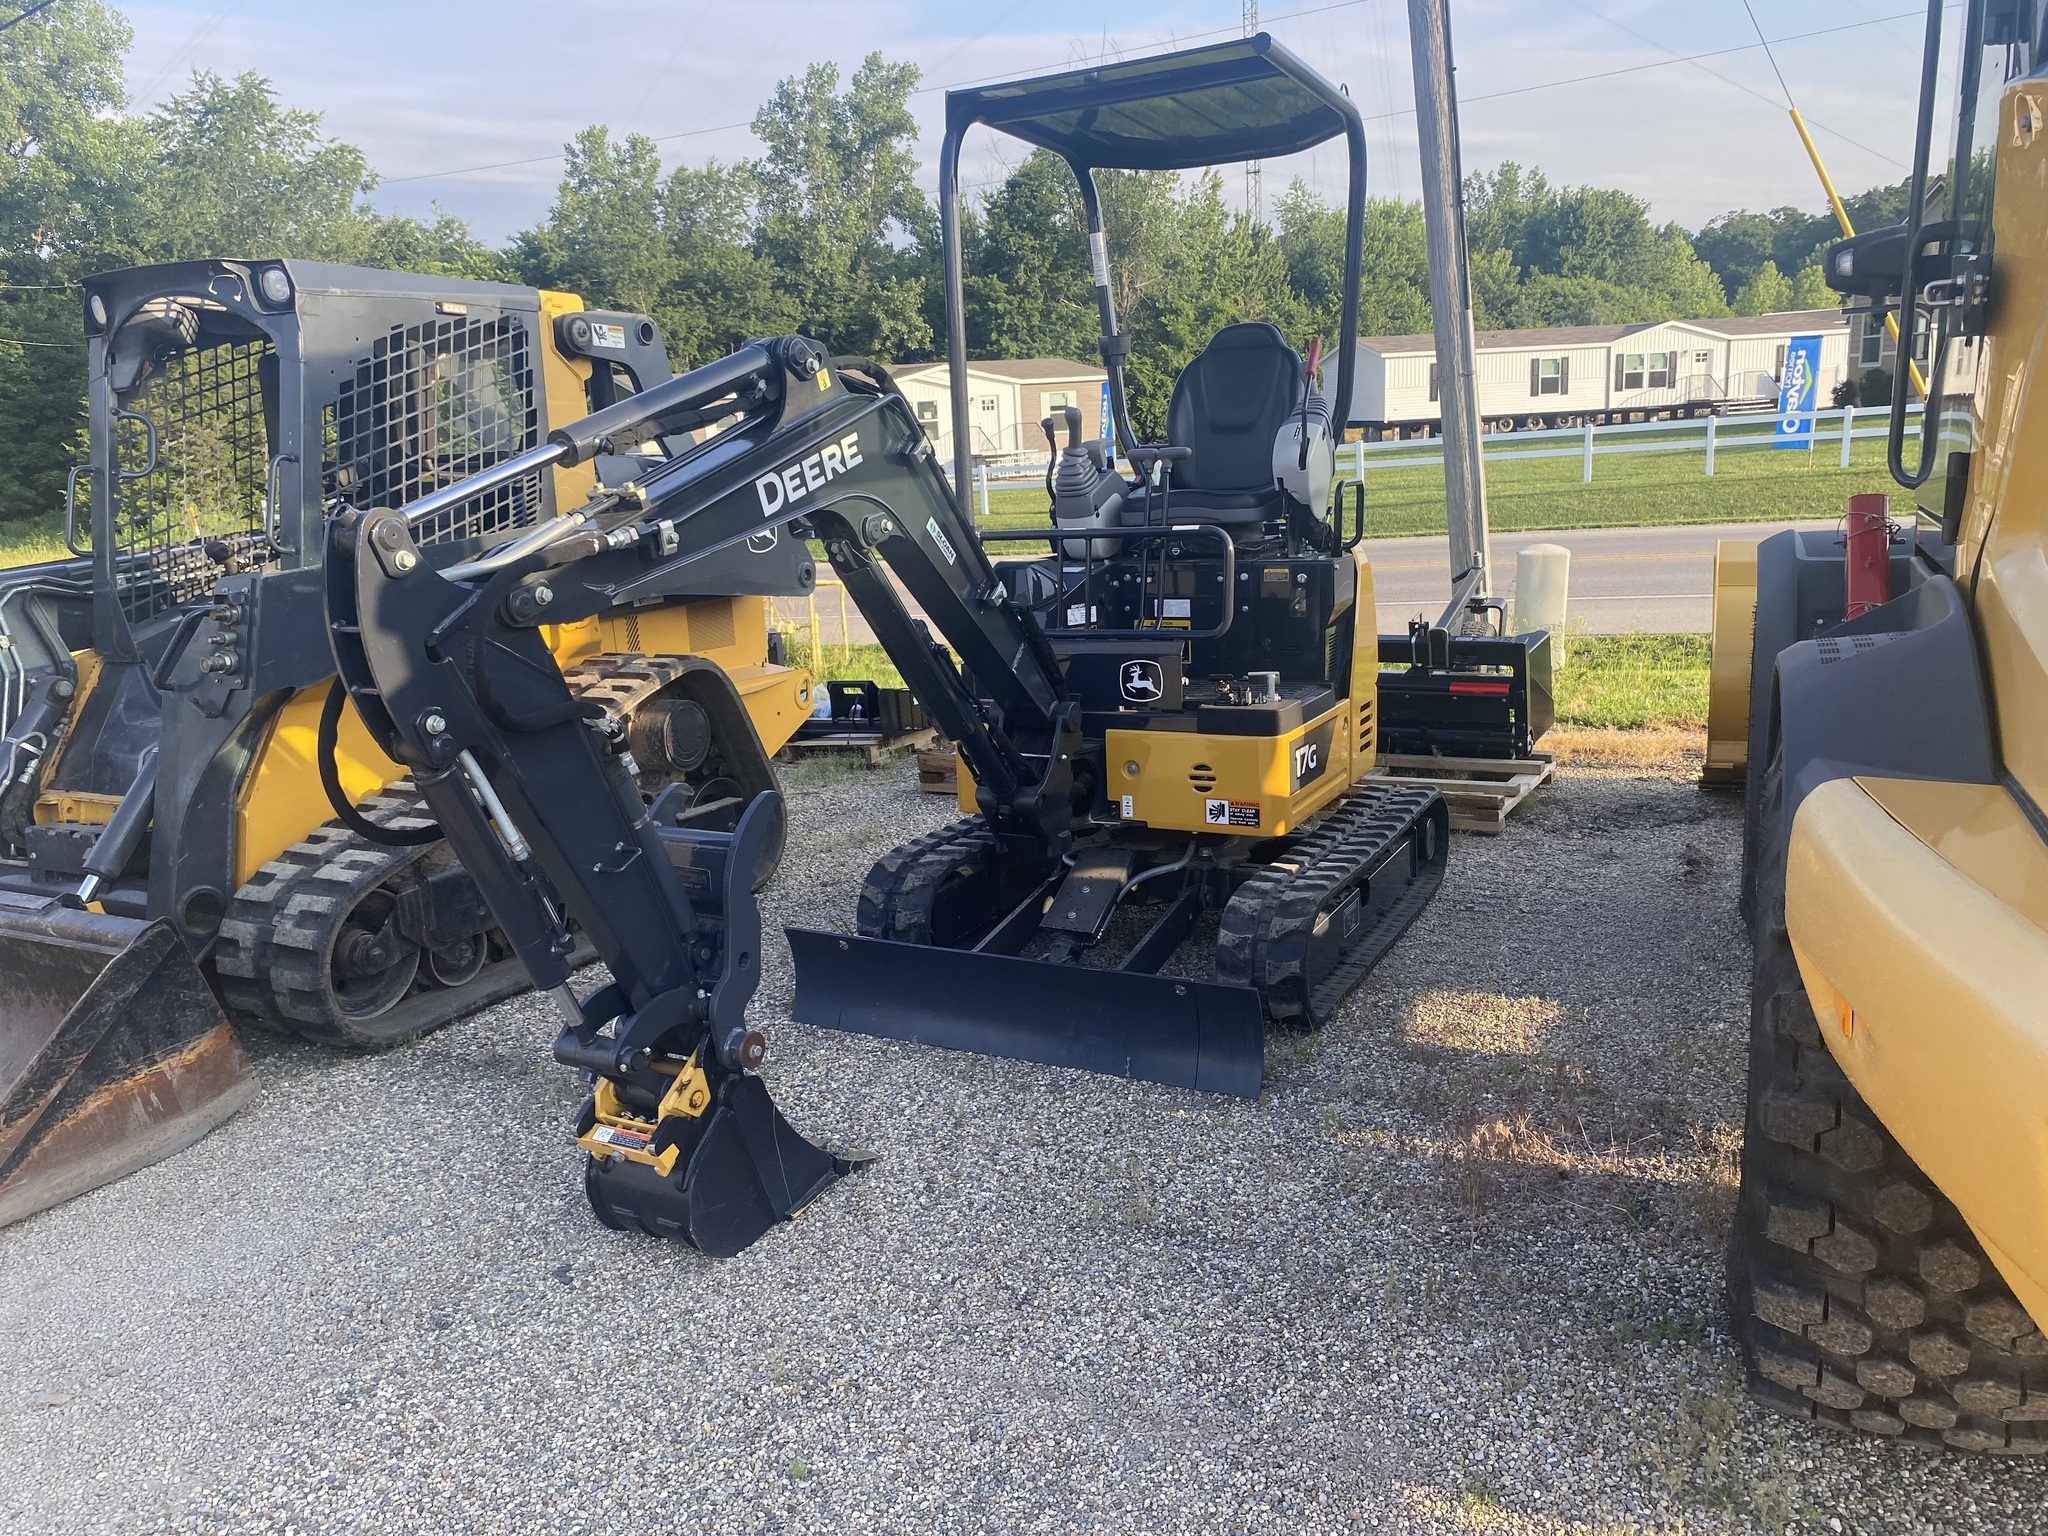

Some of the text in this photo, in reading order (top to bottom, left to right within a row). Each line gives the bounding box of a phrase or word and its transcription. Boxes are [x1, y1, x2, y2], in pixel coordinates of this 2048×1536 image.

[755, 431, 863, 517] DEERE
[935, 530, 955, 559] SLOAN
[1295, 744, 1317, 778] 17G
